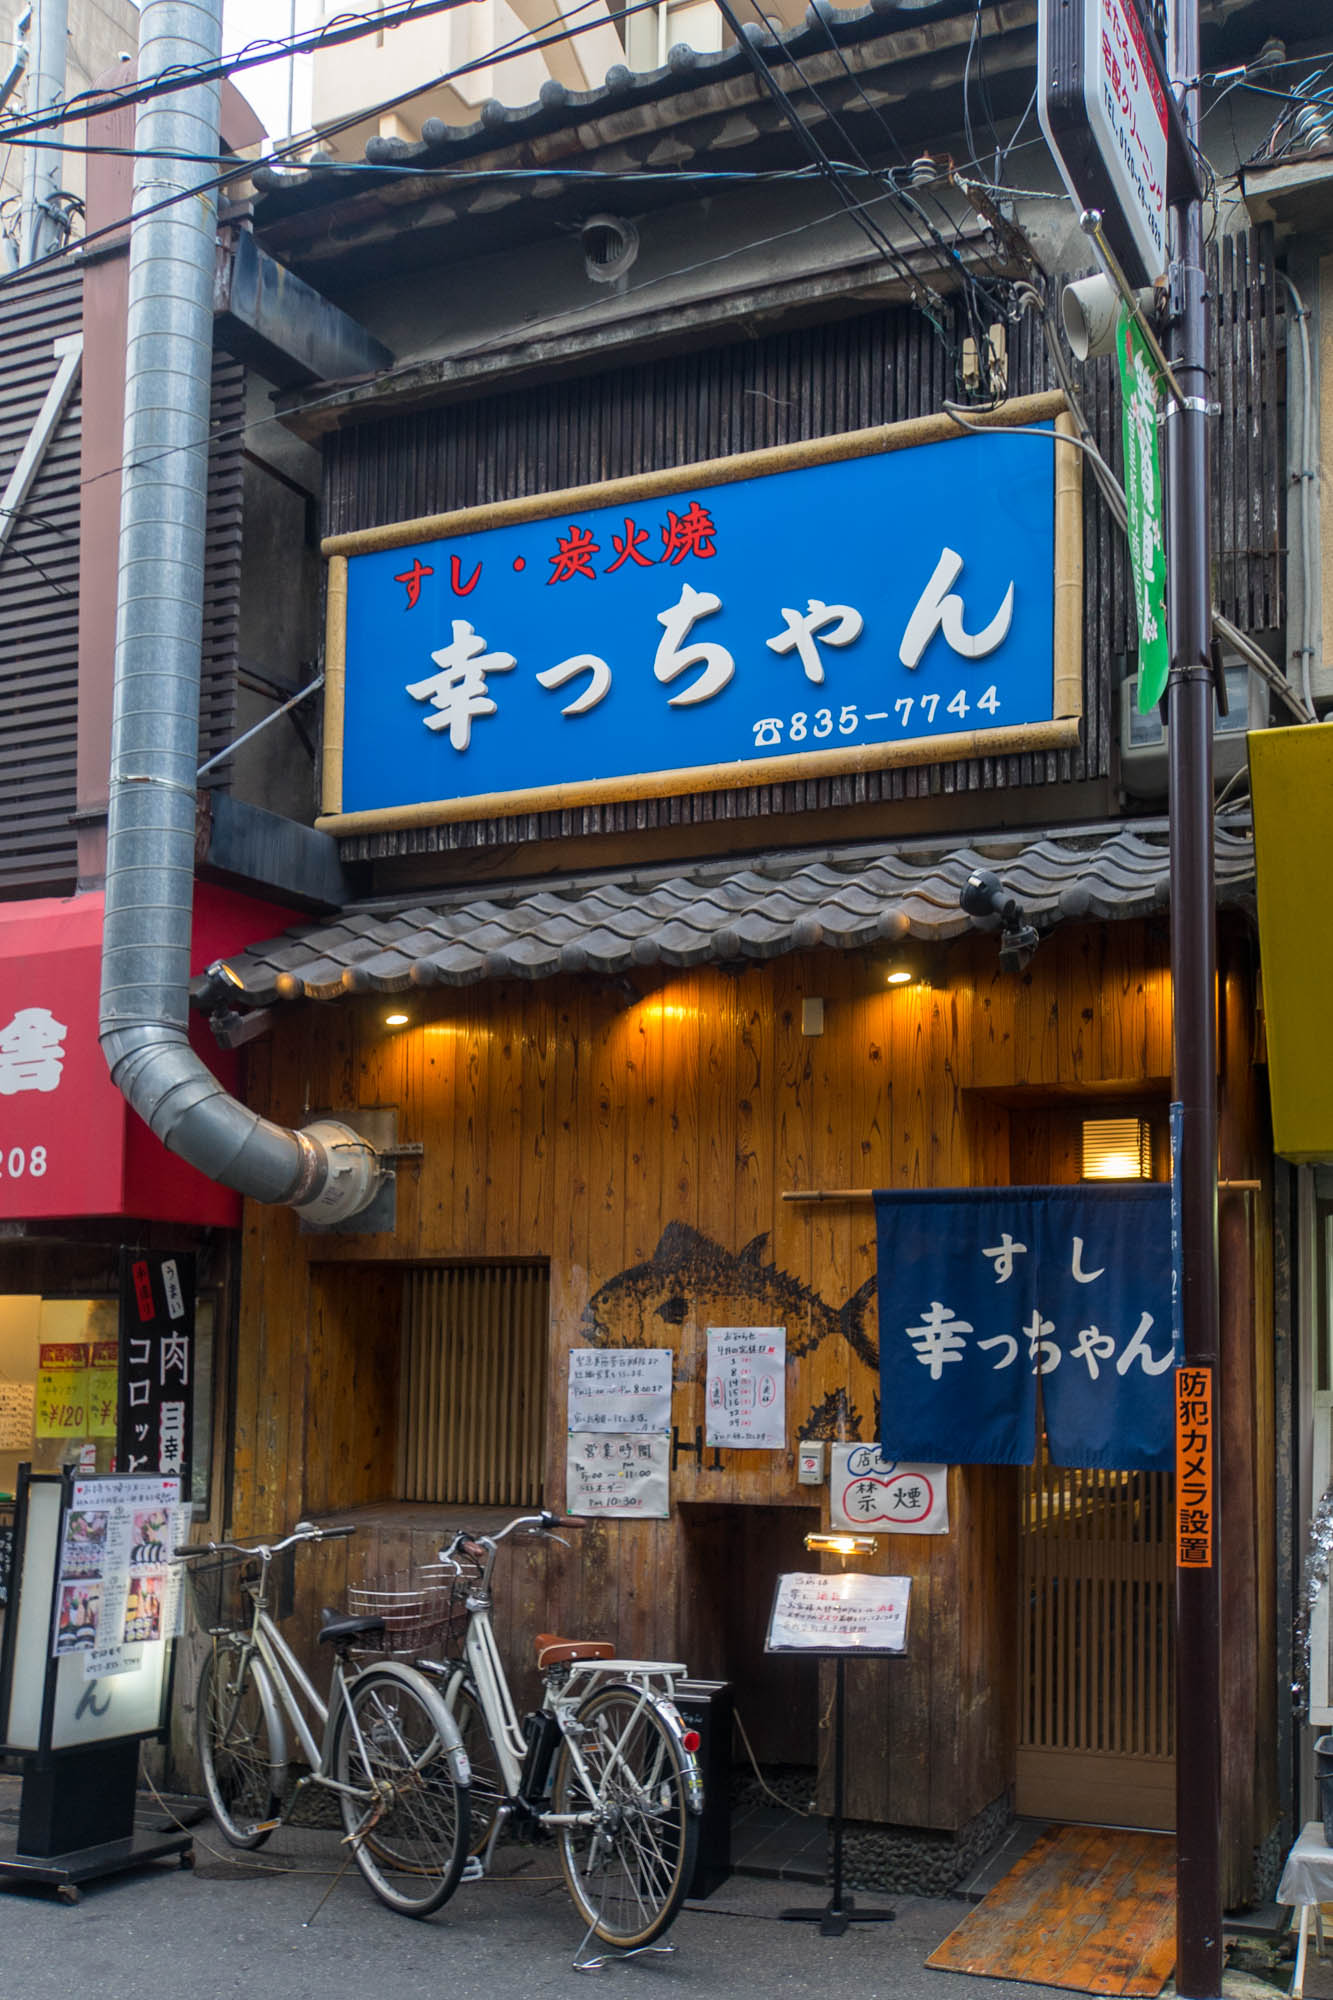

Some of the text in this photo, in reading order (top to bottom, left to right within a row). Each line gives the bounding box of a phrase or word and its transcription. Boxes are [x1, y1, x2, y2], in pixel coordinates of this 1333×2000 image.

[394, 500, 718, 612] すし・炭火焼
[405, 547, 1014, 752] 幸っちゃん
[789, 685, 1001, 743] 835-7744
[982, 1234, 1105, 1284] すし
[160, 1331, 189, 1386] 肉
[905, 1302, 1175, 1380] 幸っちゃん
[585, 1442, 652, 1459] 営業時間
[1179, 1372, 1209, 1564] 防犯カメラ設置
[856, 1482, 922, 1513] 禁煙
